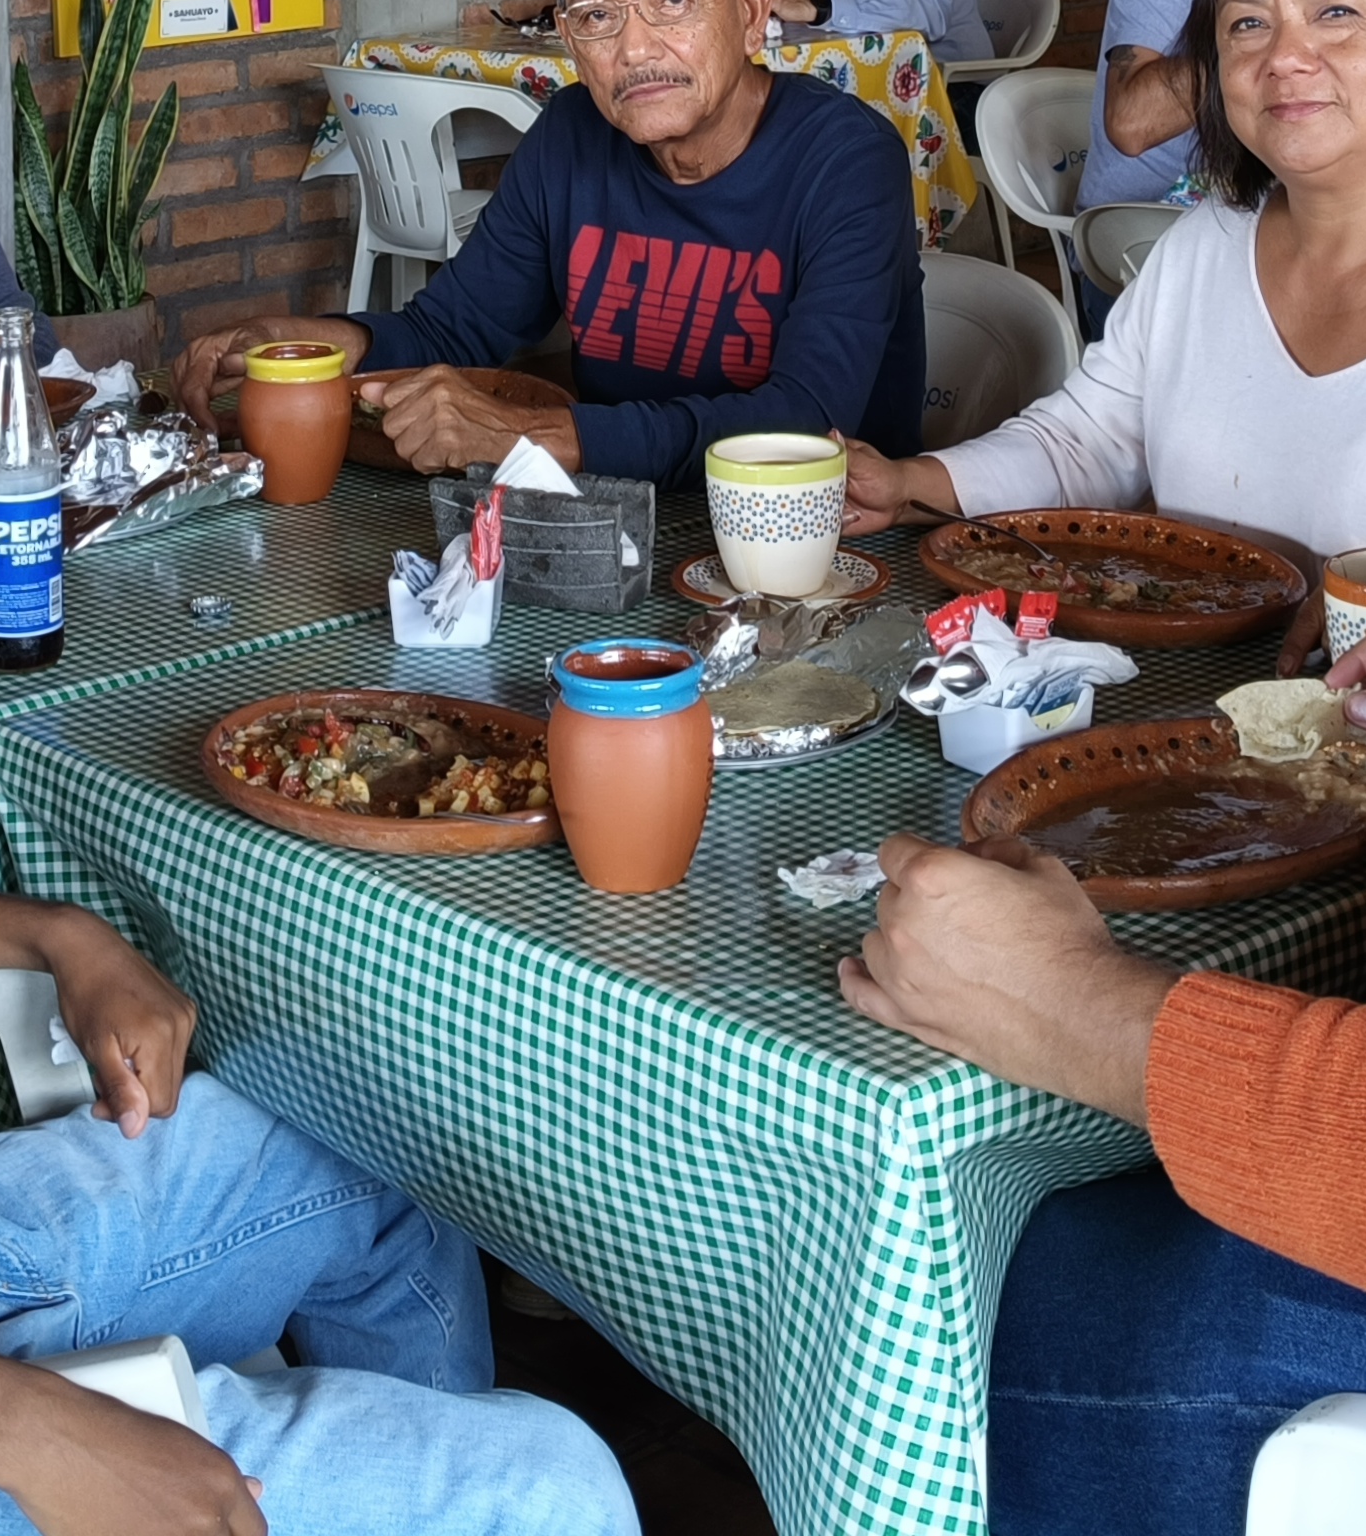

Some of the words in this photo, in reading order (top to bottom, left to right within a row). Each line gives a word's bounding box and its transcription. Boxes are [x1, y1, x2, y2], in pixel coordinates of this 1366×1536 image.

[174, 7, 214, 18] SAHUAYO
[360, 102, 398, 117] pepsi
[565, 224, 783, 389] LEVI'S
[924, 386, 960, 411] psi
